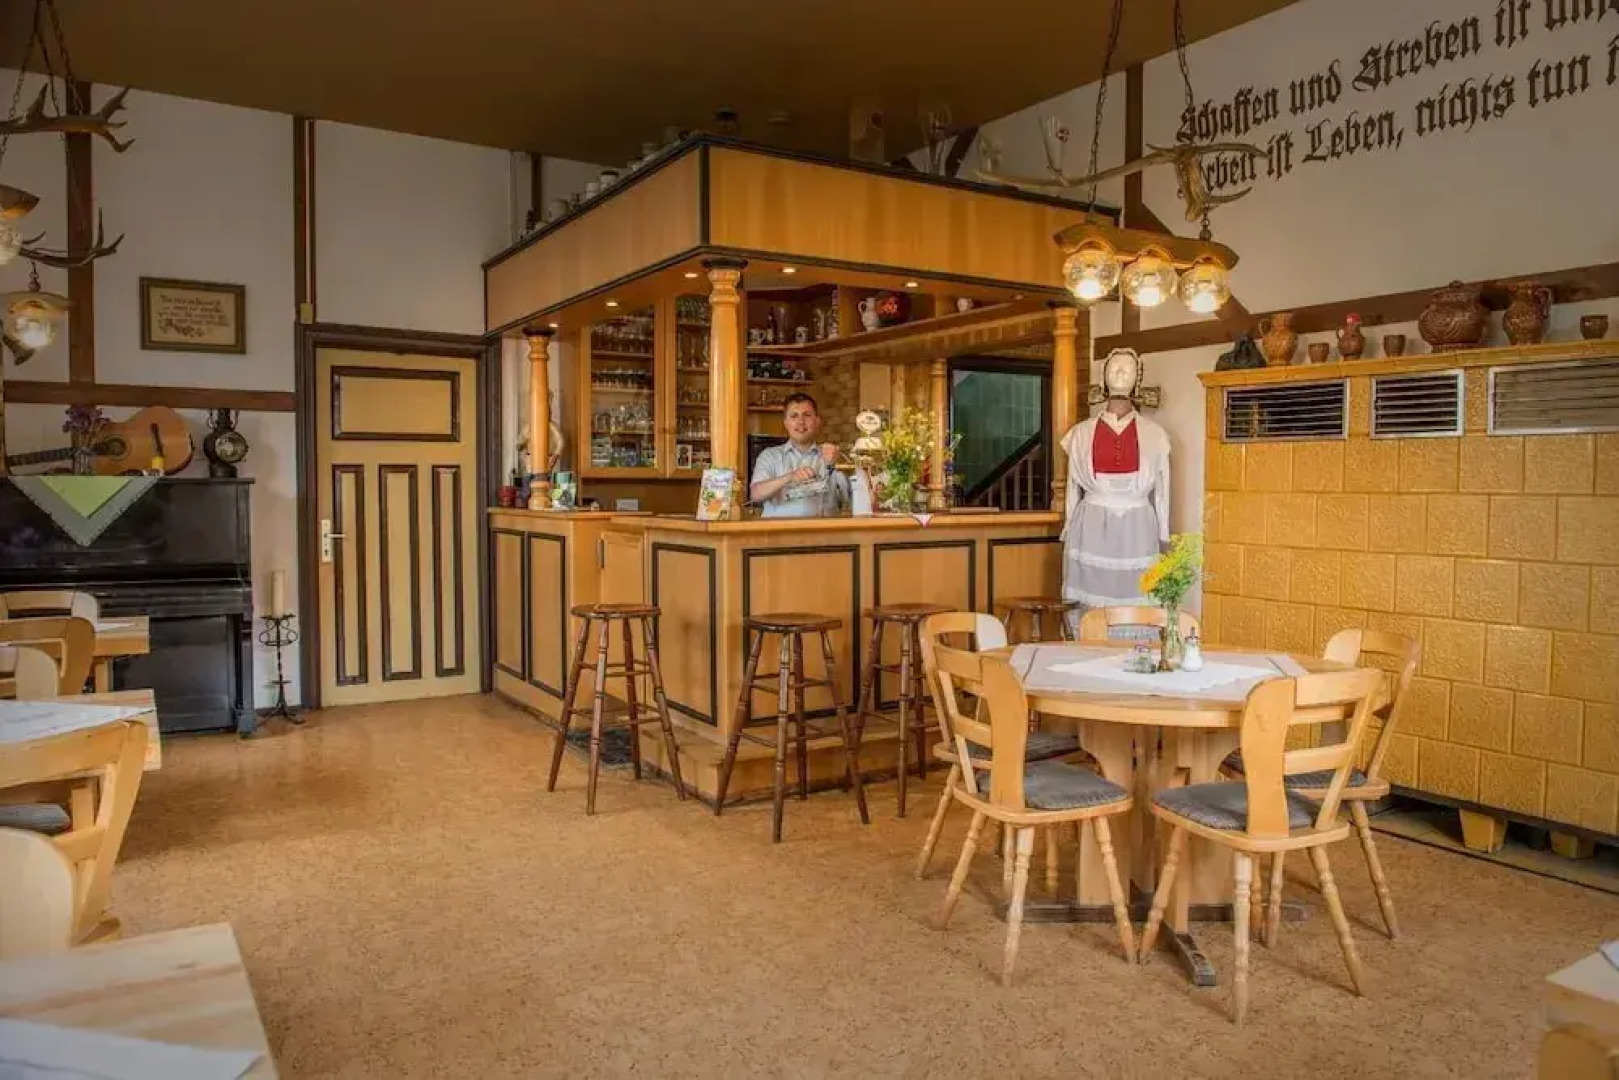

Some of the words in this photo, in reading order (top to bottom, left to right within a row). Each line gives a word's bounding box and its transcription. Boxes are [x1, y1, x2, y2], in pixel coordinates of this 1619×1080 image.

[1177, 85, 1279, 142] Schaffen
[1289, 59, 1341, 115] und
[1352, 19, 1480, 92] Streben
[1200, 151, 1256, 192] rbeit
[1302, 110, 1403, 163] Leben,
[1415, 74, 1515, 135] nichts
[1527, 55, 1590, 108] tun
